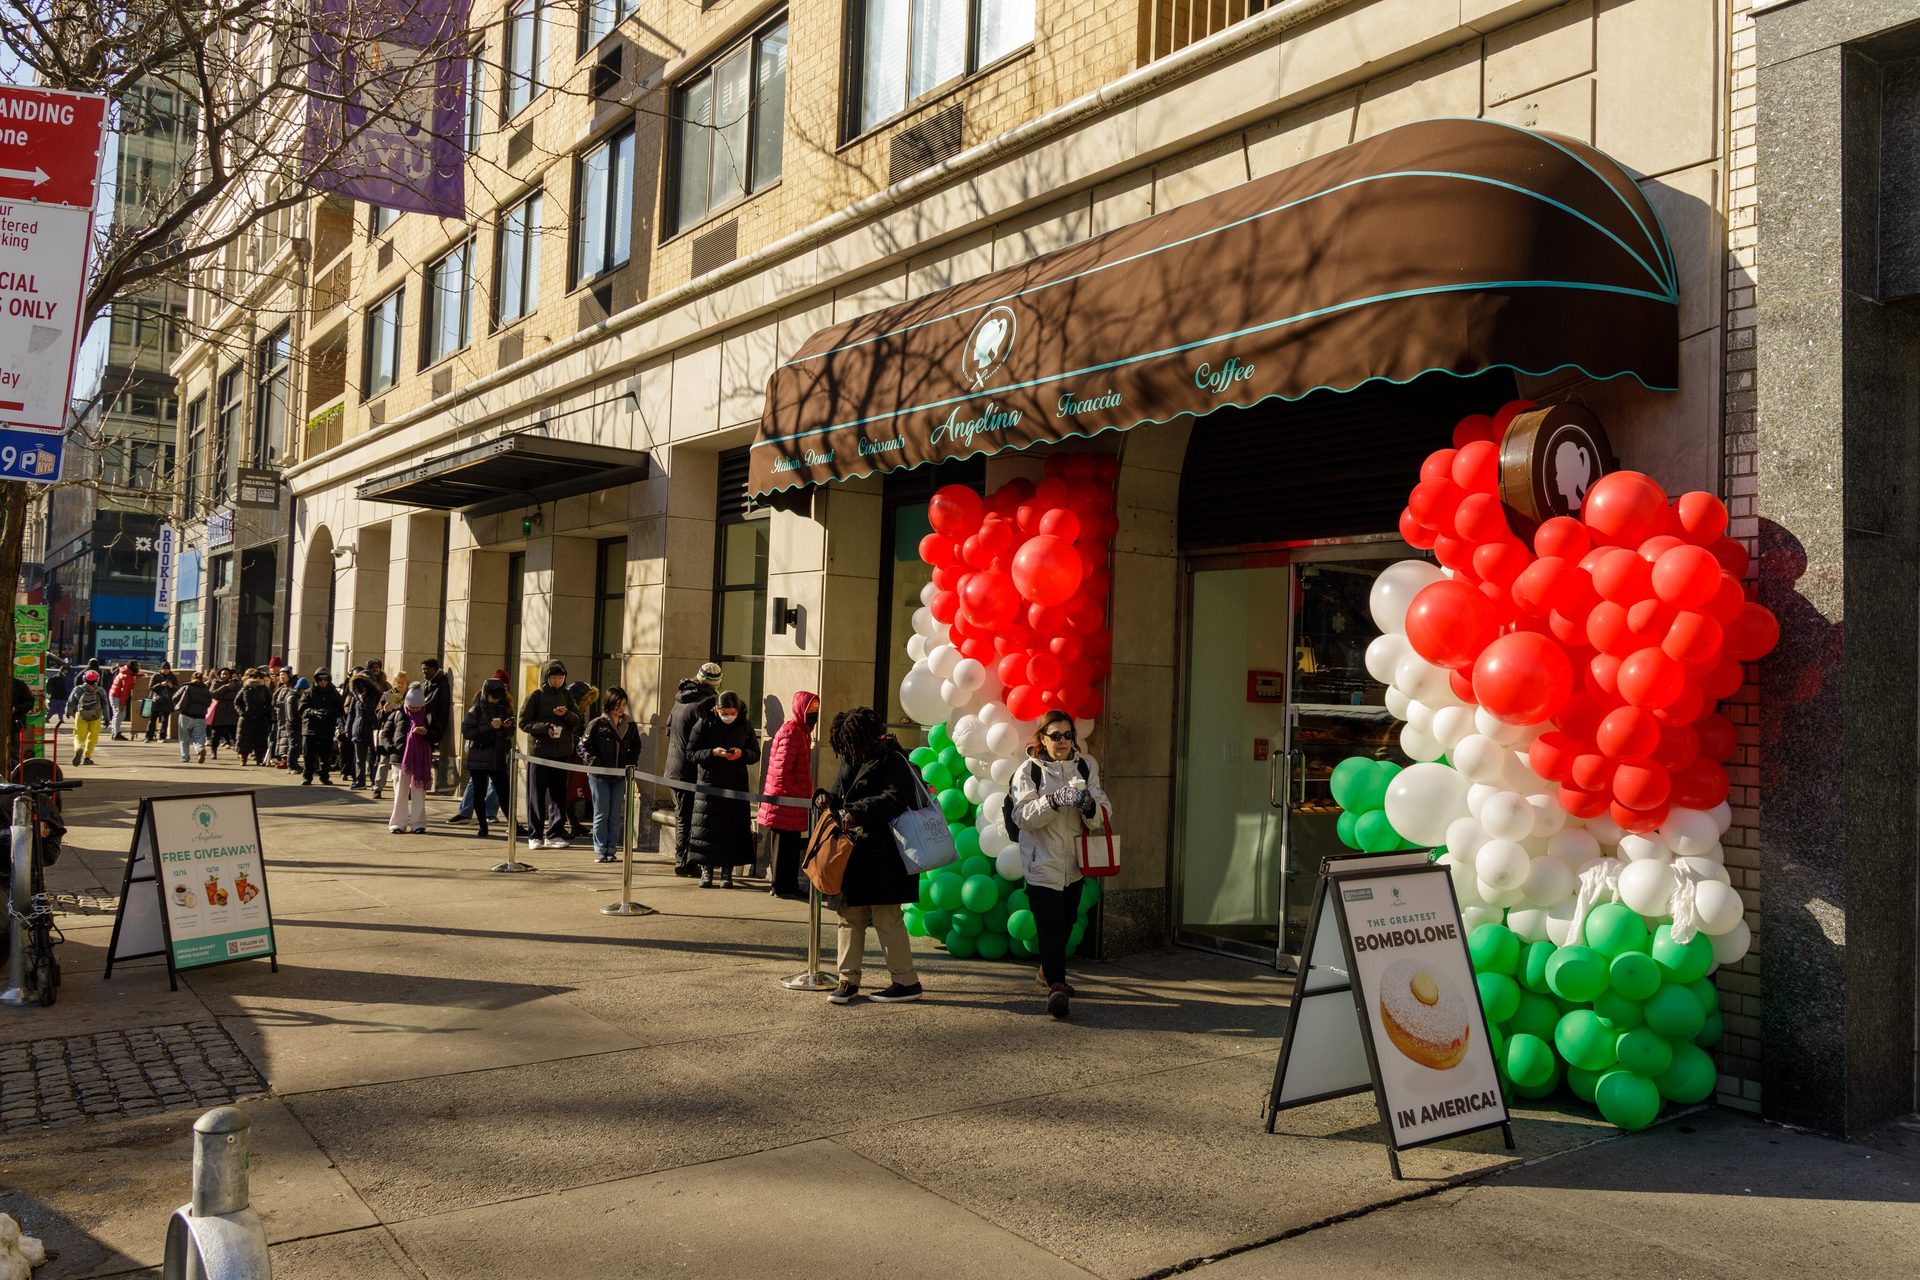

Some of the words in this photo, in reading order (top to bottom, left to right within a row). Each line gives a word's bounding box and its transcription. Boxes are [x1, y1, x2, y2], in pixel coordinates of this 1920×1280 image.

[9, 298, 58, 320] ONLY
[0, 368, 20, 389] ay
[1194, 356, 1255, 394] Coffee
[1056, 389, 1123, 418] Focaccia
[930, 402, 1023, 447] Angelina
[858, 434, 905, 457] Croissants
[770, 456, 801, 474] Italian
[804, 448, 835, 467] Donut
[159, 530, 171, 602] ROOKIE
[162, 850, 192, 863] FREE
[194, 844, 256, 860] GIVEAWAY!
[1367, 918, 1385, 928] THE
[1389, 911, 1437, 925] GREATEST
[1354, 923, 1458, 952] BOMBOLONE
[1397, 1108, 1417, 1129] IN
[1420, 1090, 1497, 1124] AMERICA!
